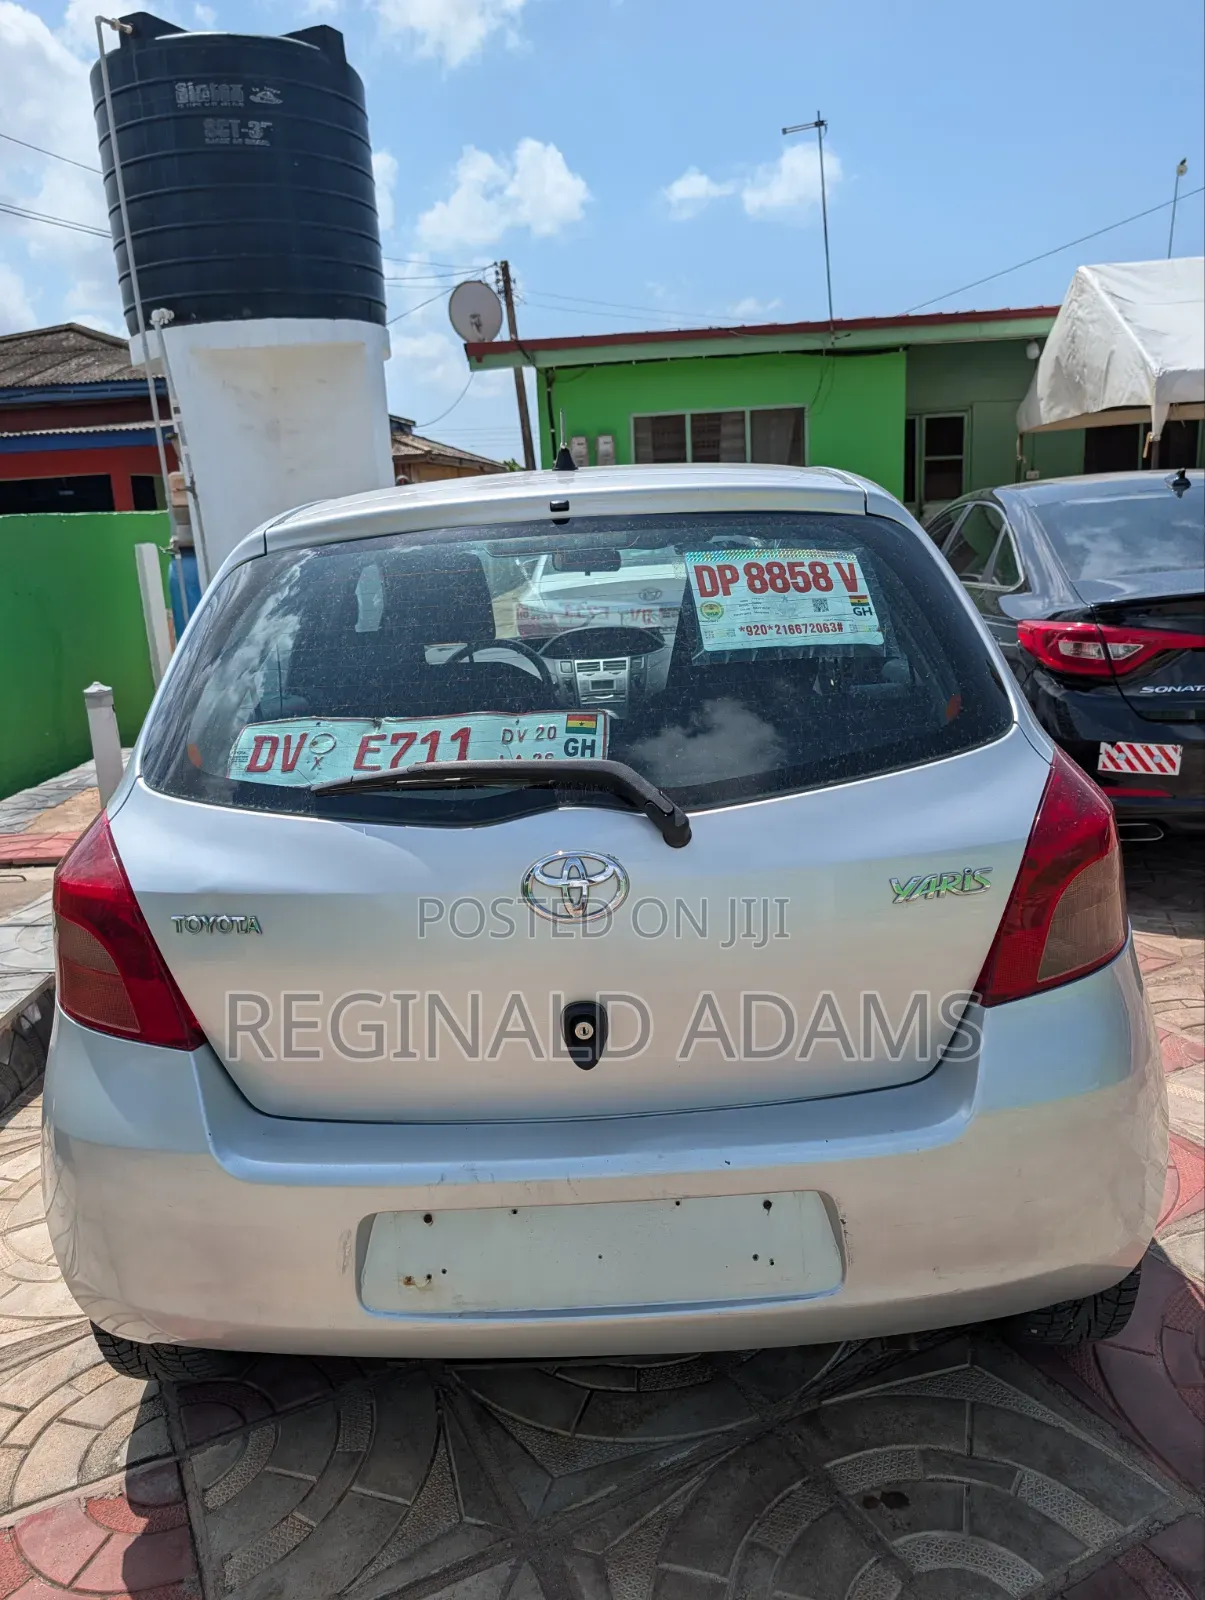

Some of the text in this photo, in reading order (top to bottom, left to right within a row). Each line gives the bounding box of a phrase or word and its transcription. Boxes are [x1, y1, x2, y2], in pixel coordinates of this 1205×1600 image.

[694, 561, 859, 597] DP 8858 V
[853, 606, 873, 616] GH
[1140, 685, 1205, 693] SONAT
[502, 726, 557, 745] DV 20
[245, 726, 472, 773] DV E711
[563, 737, 596, 758] GH
[171, 914, 263, 935] TOYOTA
